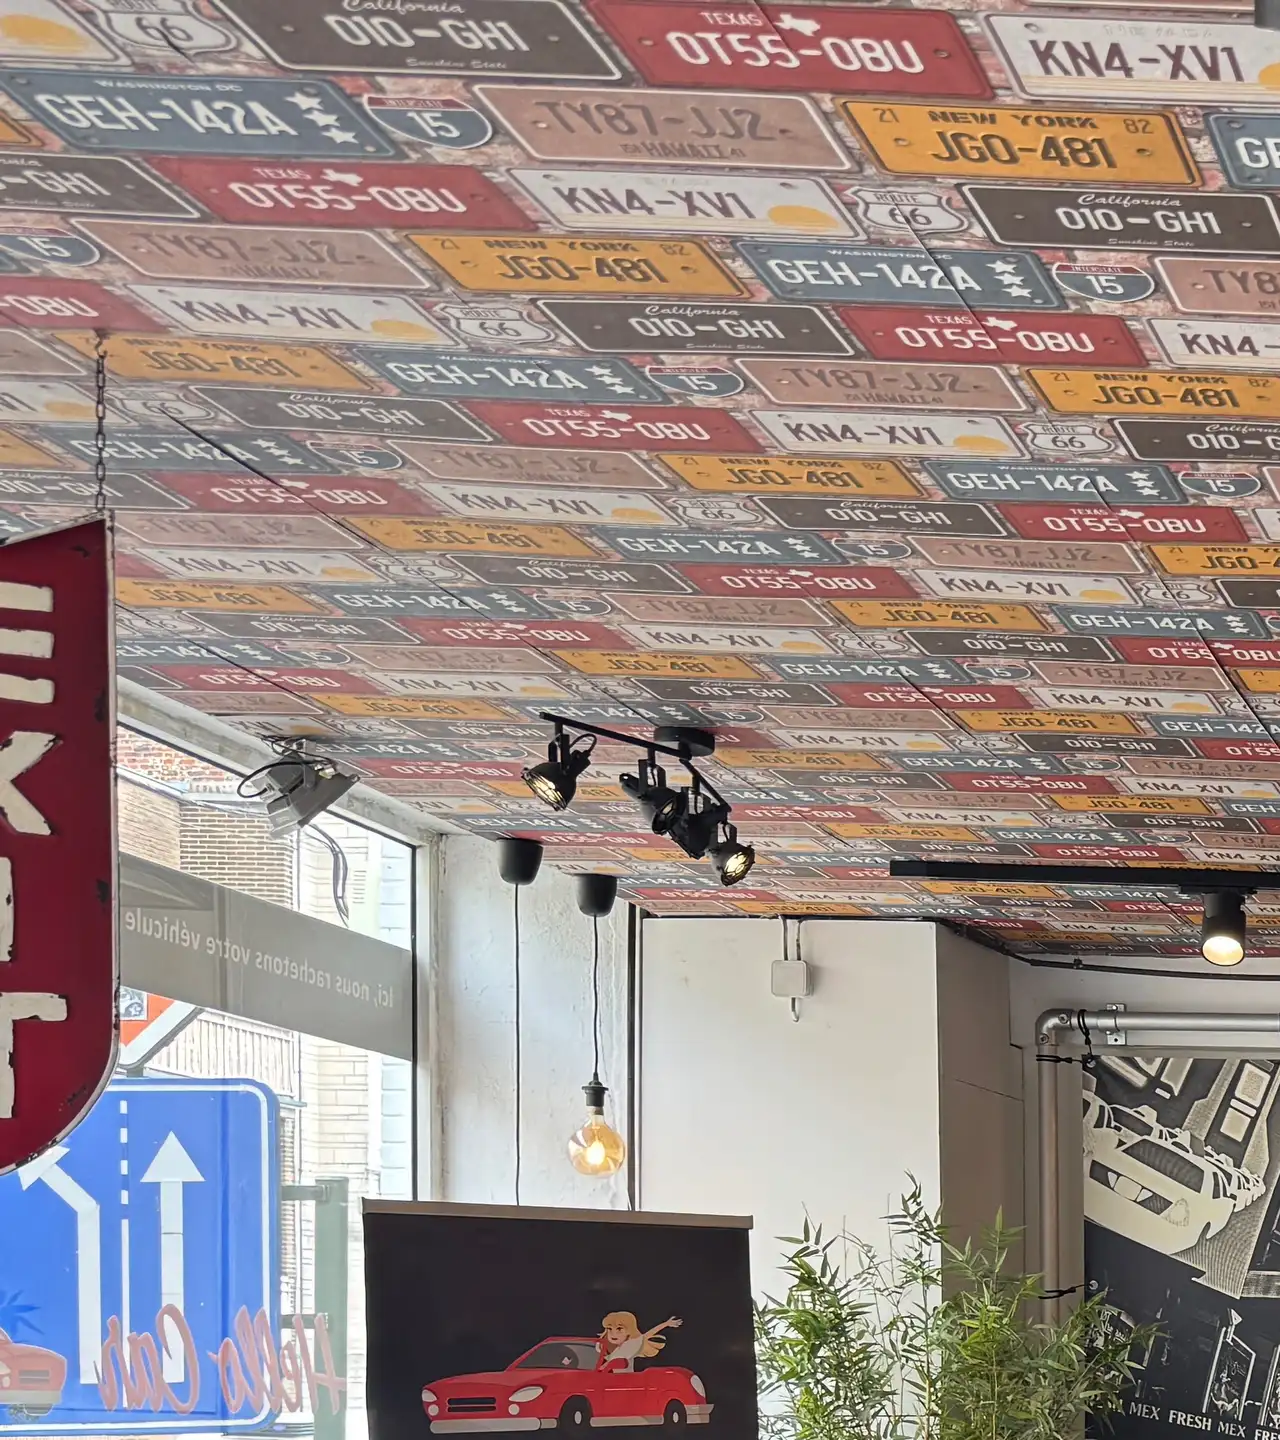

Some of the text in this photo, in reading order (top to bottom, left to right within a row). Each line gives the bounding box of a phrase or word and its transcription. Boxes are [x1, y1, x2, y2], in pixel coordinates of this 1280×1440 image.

[701, 11, 767, 27] TEXAS
[404, 111, 466, 138] 15
[872, 109, 1156, 135] 21 NEW YORK 82
[1074, 193, 1184, 207] California
[1084, 275, 1127, 294] 15
[1129, 1401, 1160, 1421] MEX
[1168, 1410, 1212, 1431] FRESH
[1217, 1423, 1246, 1438] MEX
